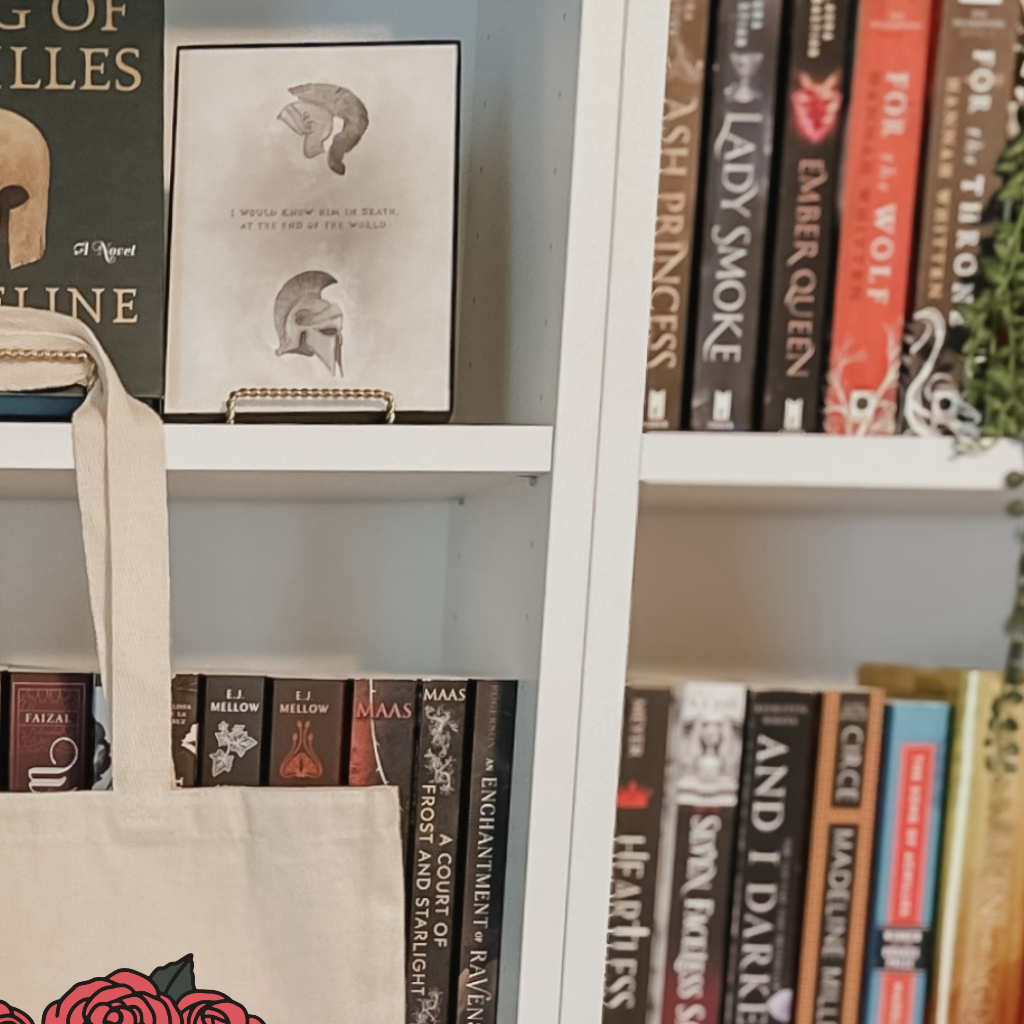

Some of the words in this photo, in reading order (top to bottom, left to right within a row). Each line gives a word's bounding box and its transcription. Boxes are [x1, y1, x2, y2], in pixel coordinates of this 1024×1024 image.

[51, 0, 126, 31] OF
[880, 71, 910, 138] FOR
[966, 49, 997, 115] FOR
[659, 97, 700, 176] ASH
[713, 112, 764, 218] LADY
[239, 209, 276, 217] WOULD
[281, 208, 314, 217] KNOW
[786, 158, 829, 267] EMBER
[73, 241, 89, 257] A
[92, 240, 136, 264] Novel
[866, 203, 898, 305] WOLF
[702, 224, 752, 363] SMOKE
[784, 268, 818, 378] QUEEN
[25, 712, 72, 724] FAIZAL
[210, 701, 260, 713] MELLOW
[279, 703, 330, 714] MELLOW
[356, 702, 412, 719] MAAS
[423, 688, 466, 701] MAAS
[750, 733, 800, 833] AND
[833, 724, 865, 804] CIRCE
[419, 784, 437, 844] FROST
[438, 833, 454, 847] A
[416, 849, 433, 890] AND
[435, 852, 453, 916] COURT
[473, 776, 498, 929] ENCHANTMENT
[747, 851, 782, 864] I
[410, 897, 430, 996] STARLIGHT
[433, 921, 450, 948] OF
[603, 834, 651, 1010] HEARTLESS
